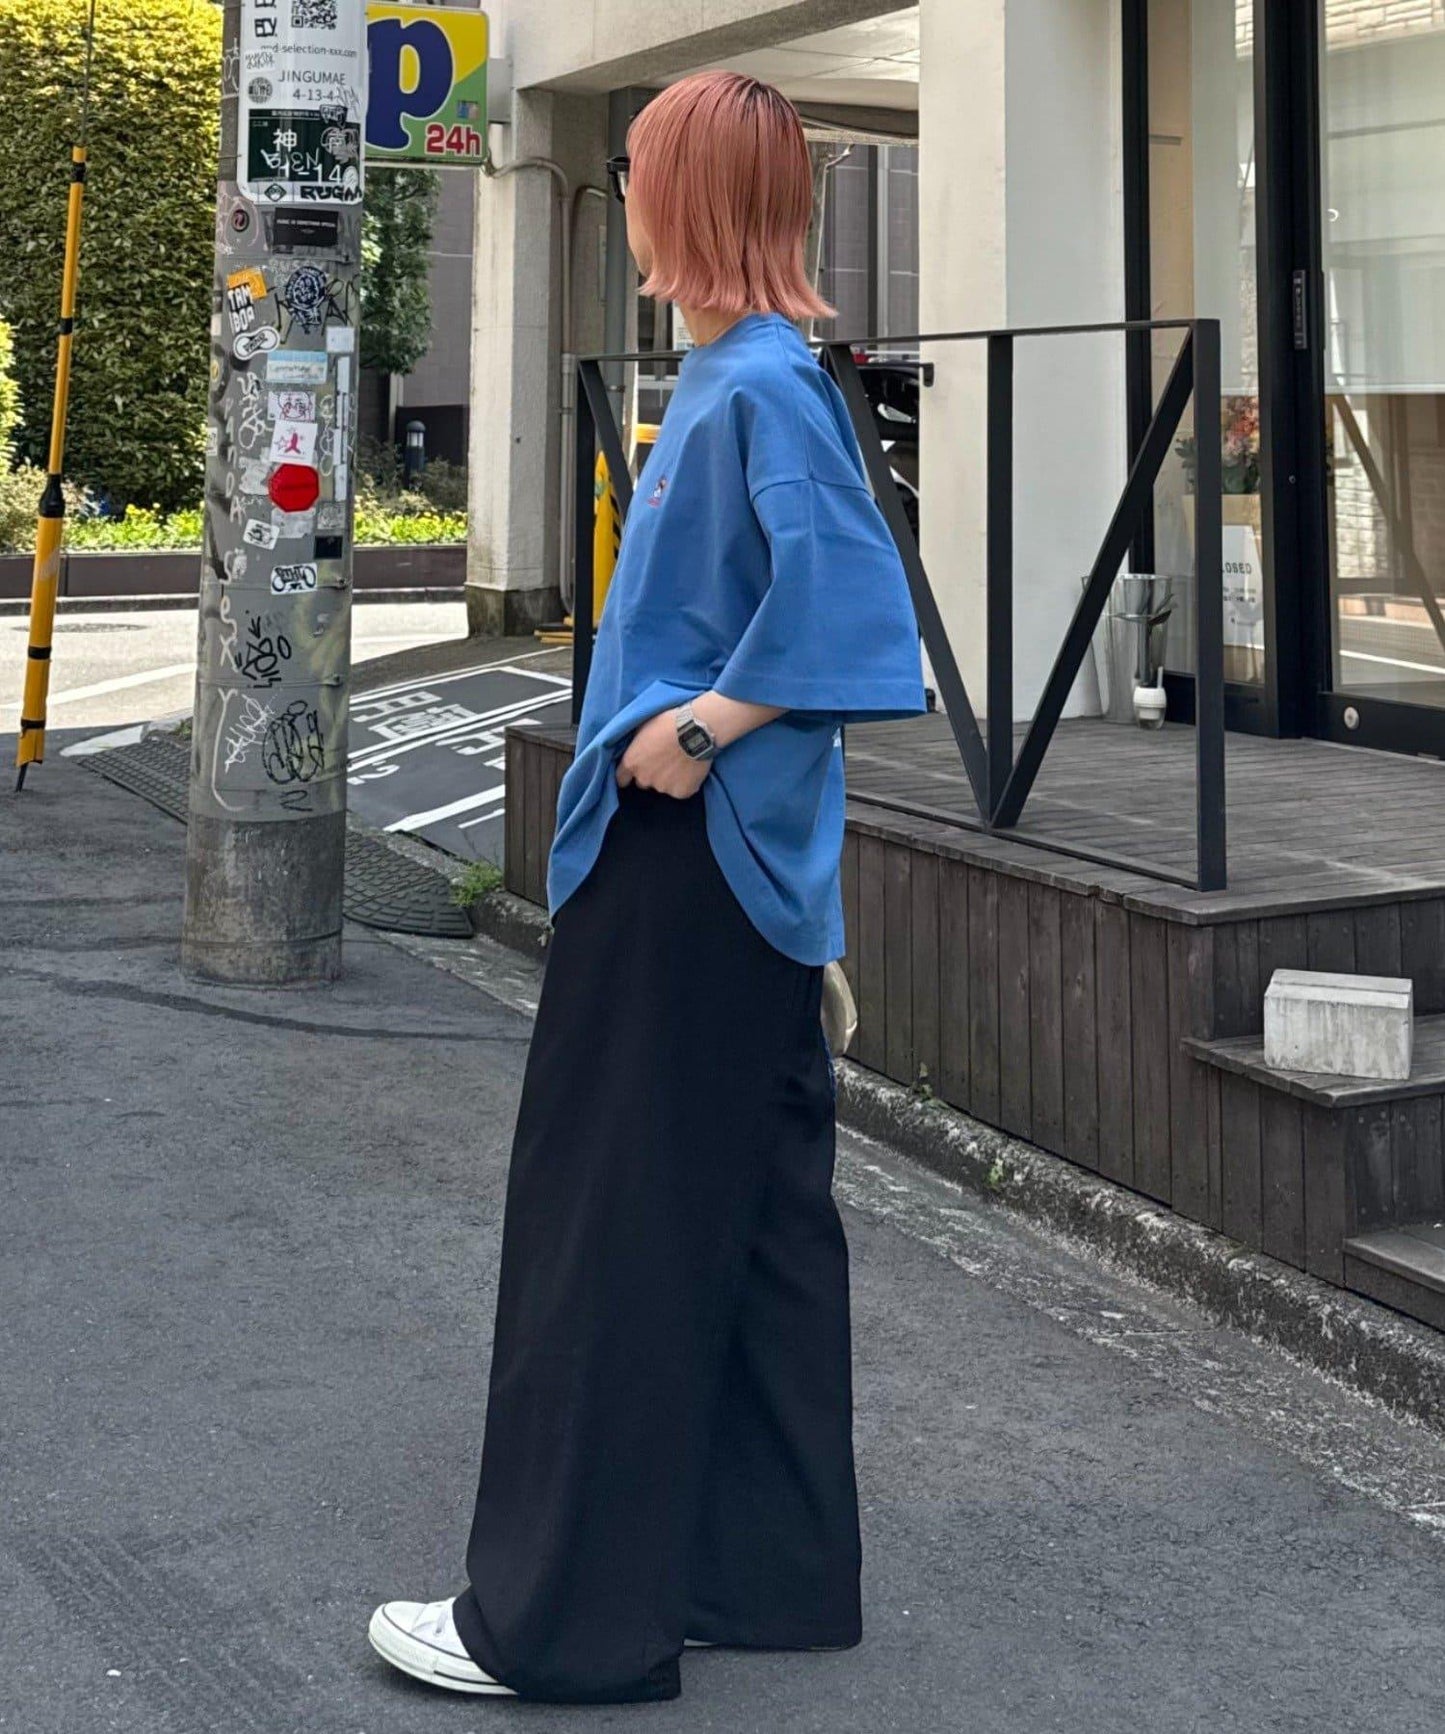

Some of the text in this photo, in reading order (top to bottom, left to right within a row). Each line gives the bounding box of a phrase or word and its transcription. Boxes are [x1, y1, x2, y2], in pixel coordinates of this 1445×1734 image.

[277, 69, 347, 86] JINGUMAE
[425, 123, 481, 157] 24h
[1221, 562, 1252, 575] OSED
